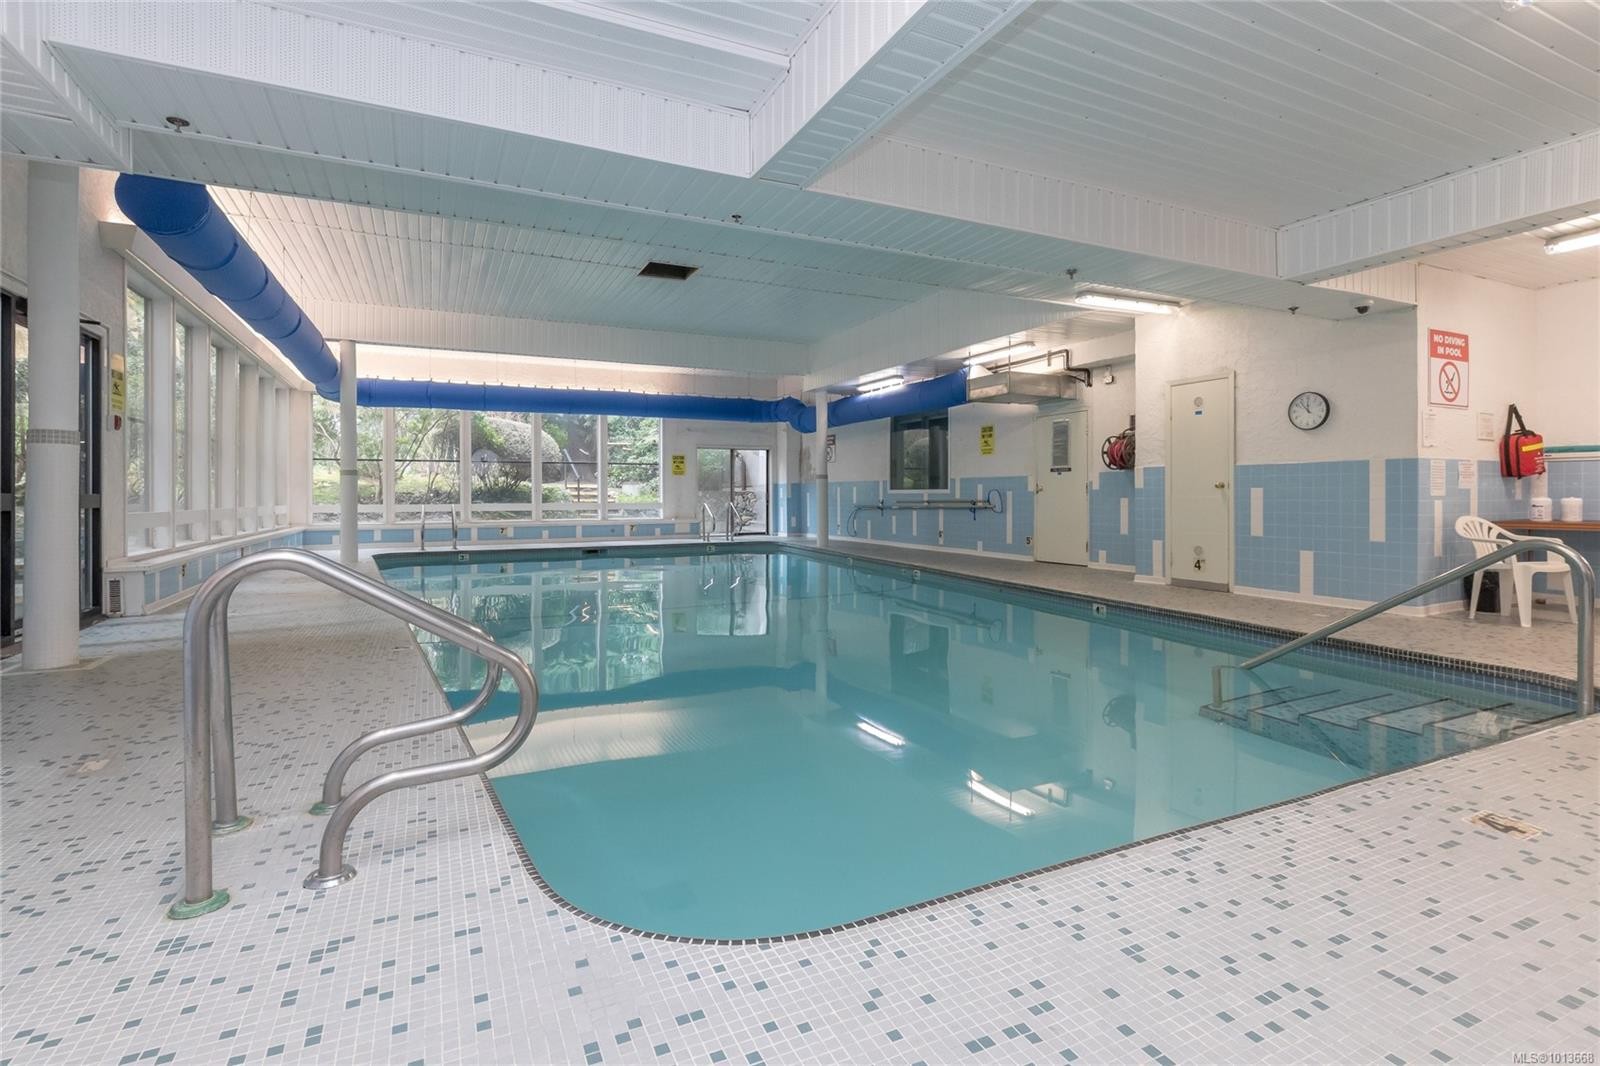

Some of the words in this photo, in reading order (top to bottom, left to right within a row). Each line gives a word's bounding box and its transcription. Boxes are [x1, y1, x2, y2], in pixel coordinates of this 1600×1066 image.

[1433, 333, 1444, 343] NO
[1444, 335, 1465, 347] DIVING
[1437, 345, 1445, 355] IN
[1445, 347, 1462, 358] POOL
